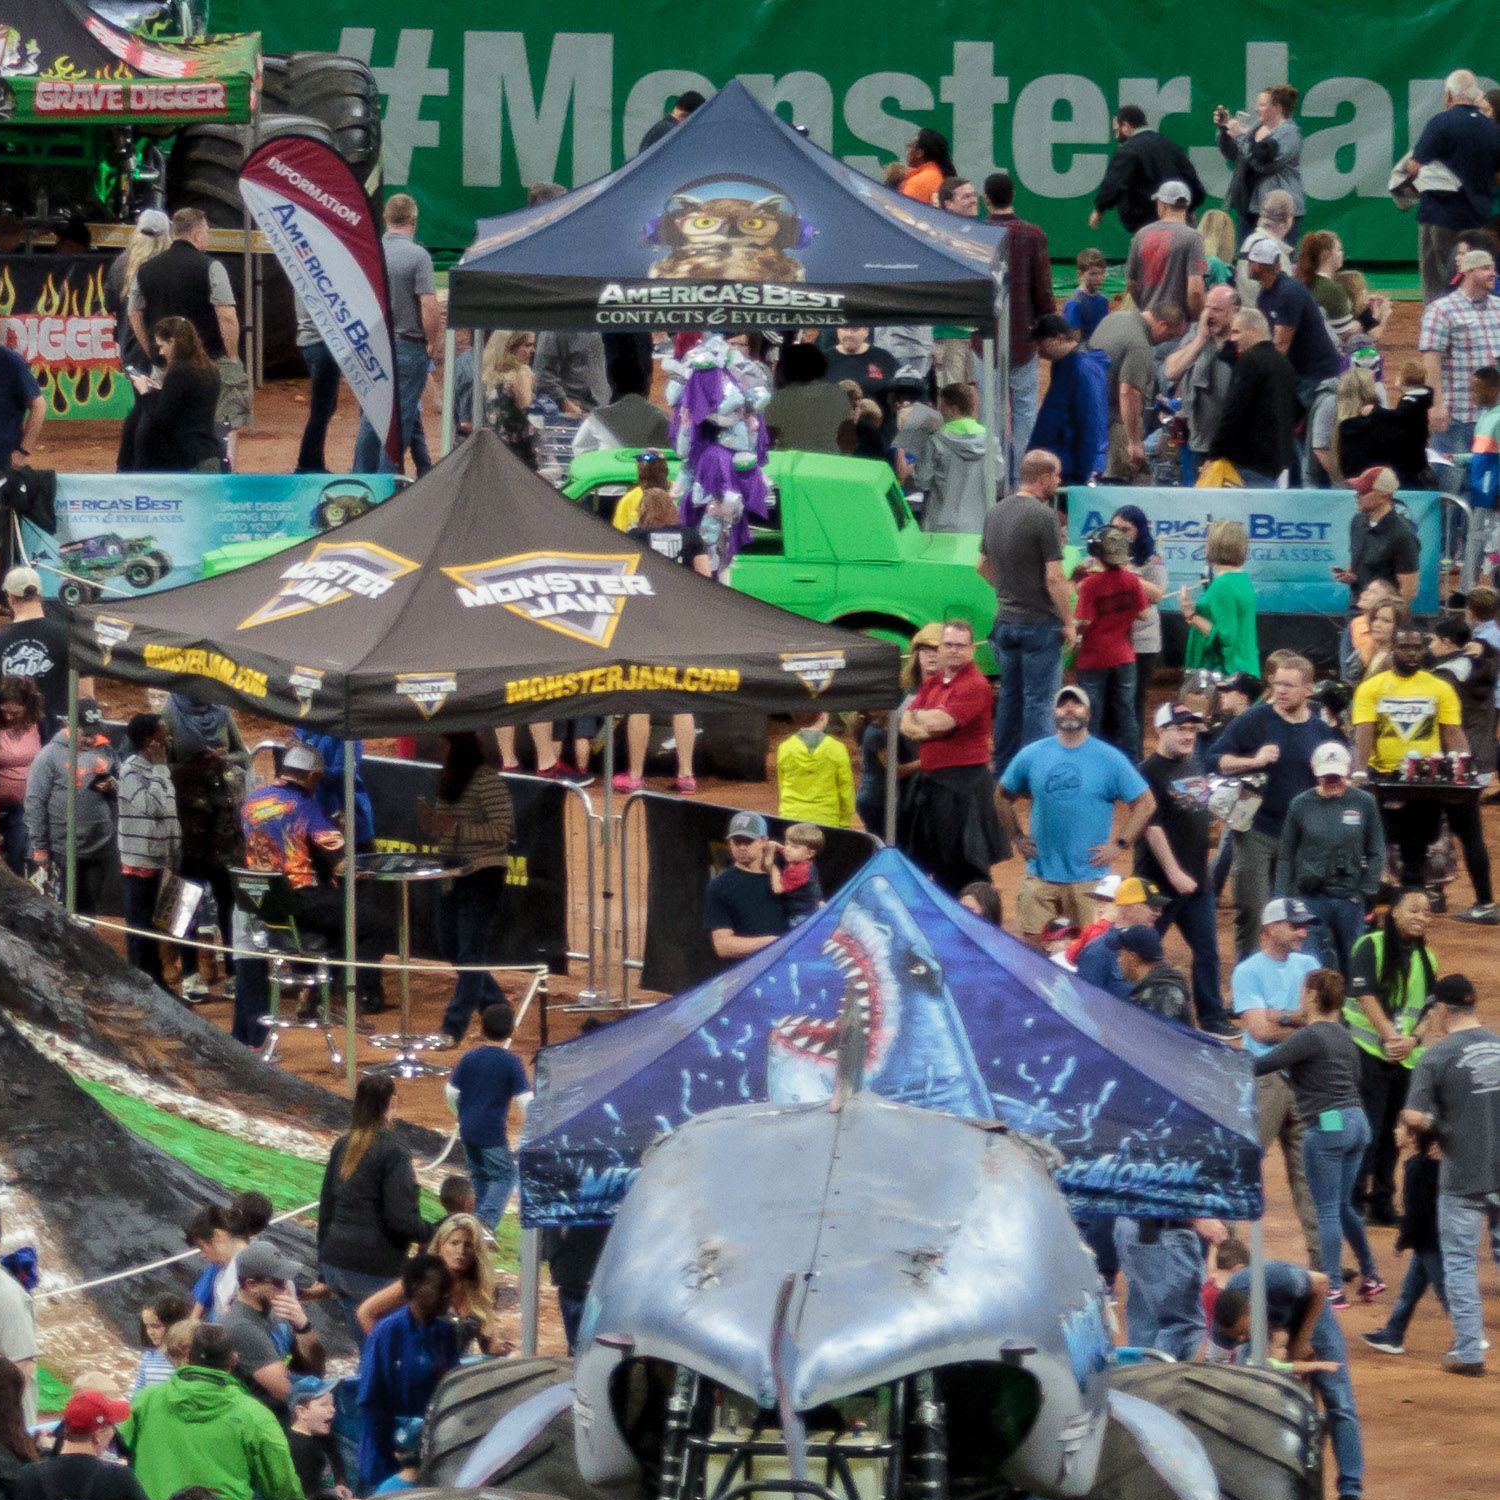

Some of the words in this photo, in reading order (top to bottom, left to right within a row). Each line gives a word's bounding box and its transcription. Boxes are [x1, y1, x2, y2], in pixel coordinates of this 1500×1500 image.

[34, 81, 124, 113] GRAVE
[128, 82, 226, 112] DIGGER
[265, 156, 363, 227] INFORMATION
[271, 202, 351, 324] AMERICA'S
[343, 319, 389, 385] BEST
[597, 282, 760, 305] AMERICA'S
[761, 284, 846, 308] BEST
[595, 309, 705, 325] CONTACTS
[730, 310, 848, 326] EYEGLASSES
[0, 316, 121, 361] DIGGE
[55, 498, 134, 512] MERICA'S
[134, 495, 183, 512] BEST
[1249, 513, 1332, 541] BEST
[455, 571, 656, 609] MONSTER
[529, 593, 616, 619] JAM
[505, 664, 742, 704] MONSTERJAM.COM
